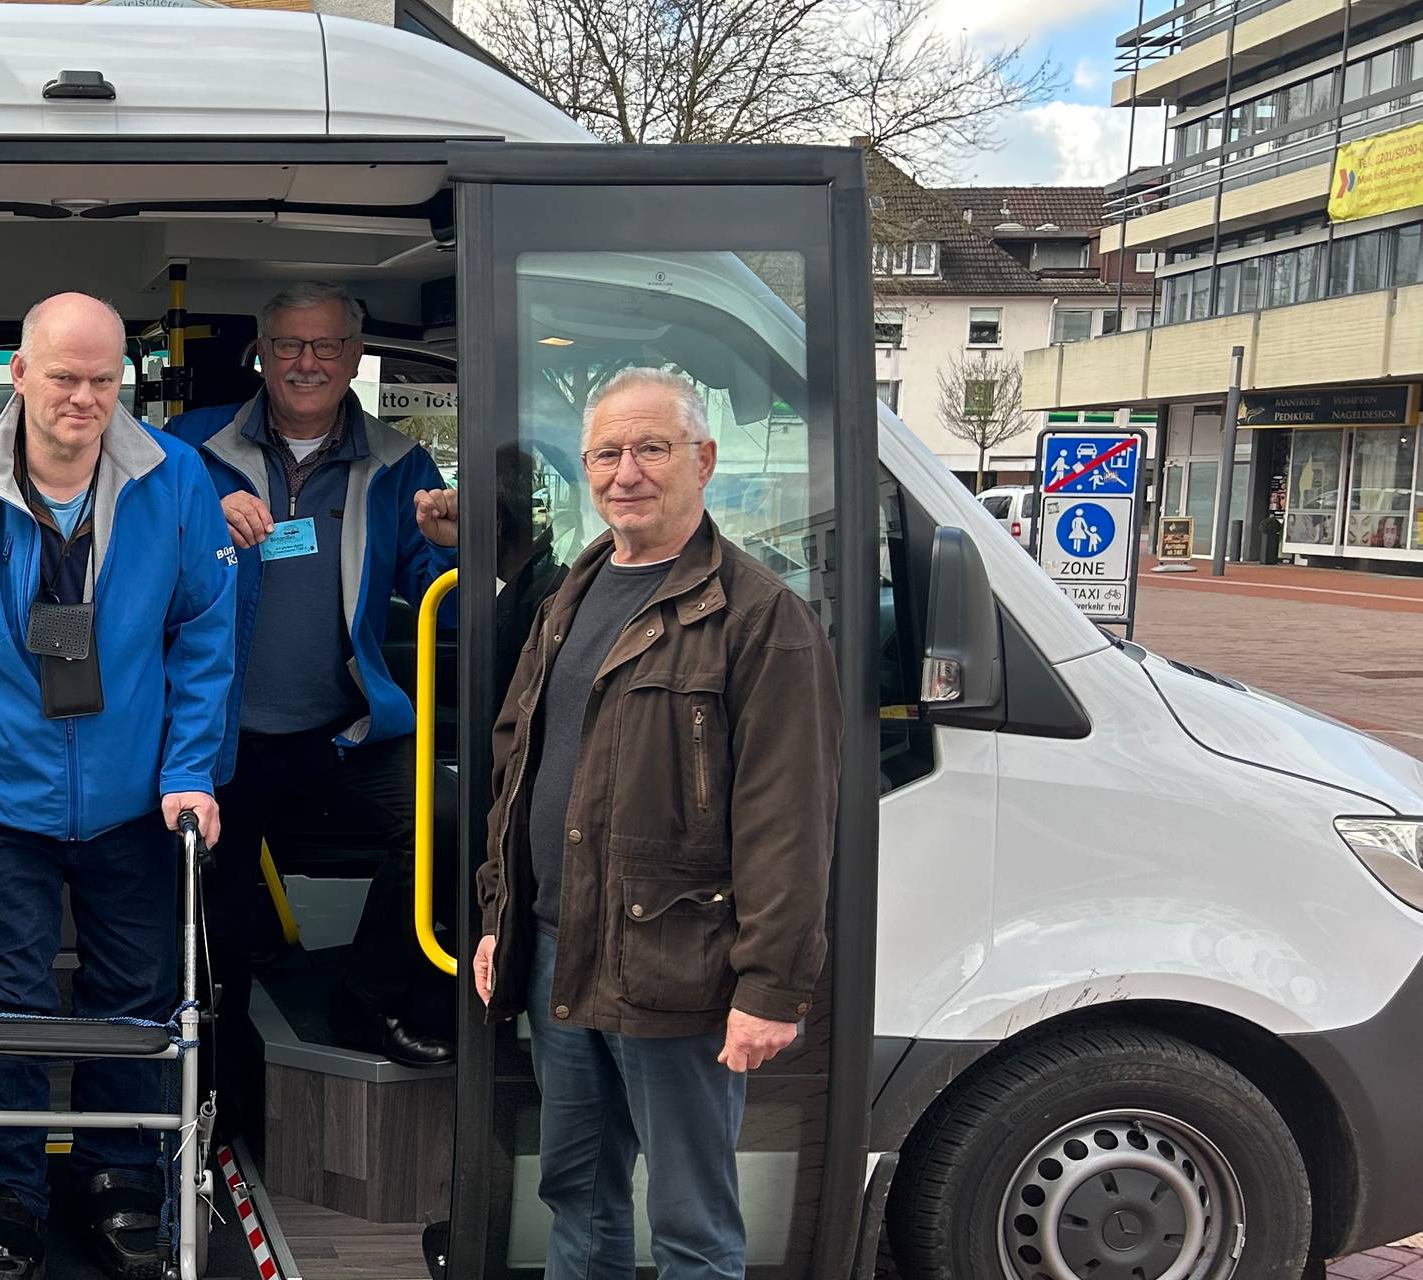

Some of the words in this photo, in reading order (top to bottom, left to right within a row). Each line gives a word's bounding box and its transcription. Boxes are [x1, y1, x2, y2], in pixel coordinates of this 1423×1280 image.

[1331, 408, 1397, 420] NAGELDESIGN
[1061, 562, 1105, 575] ZONE
[1072, 588, 1100, 600] TAXI
[1074, 602, 1105, 611] verkehr
[1108, 602, 1122, 612] frei
